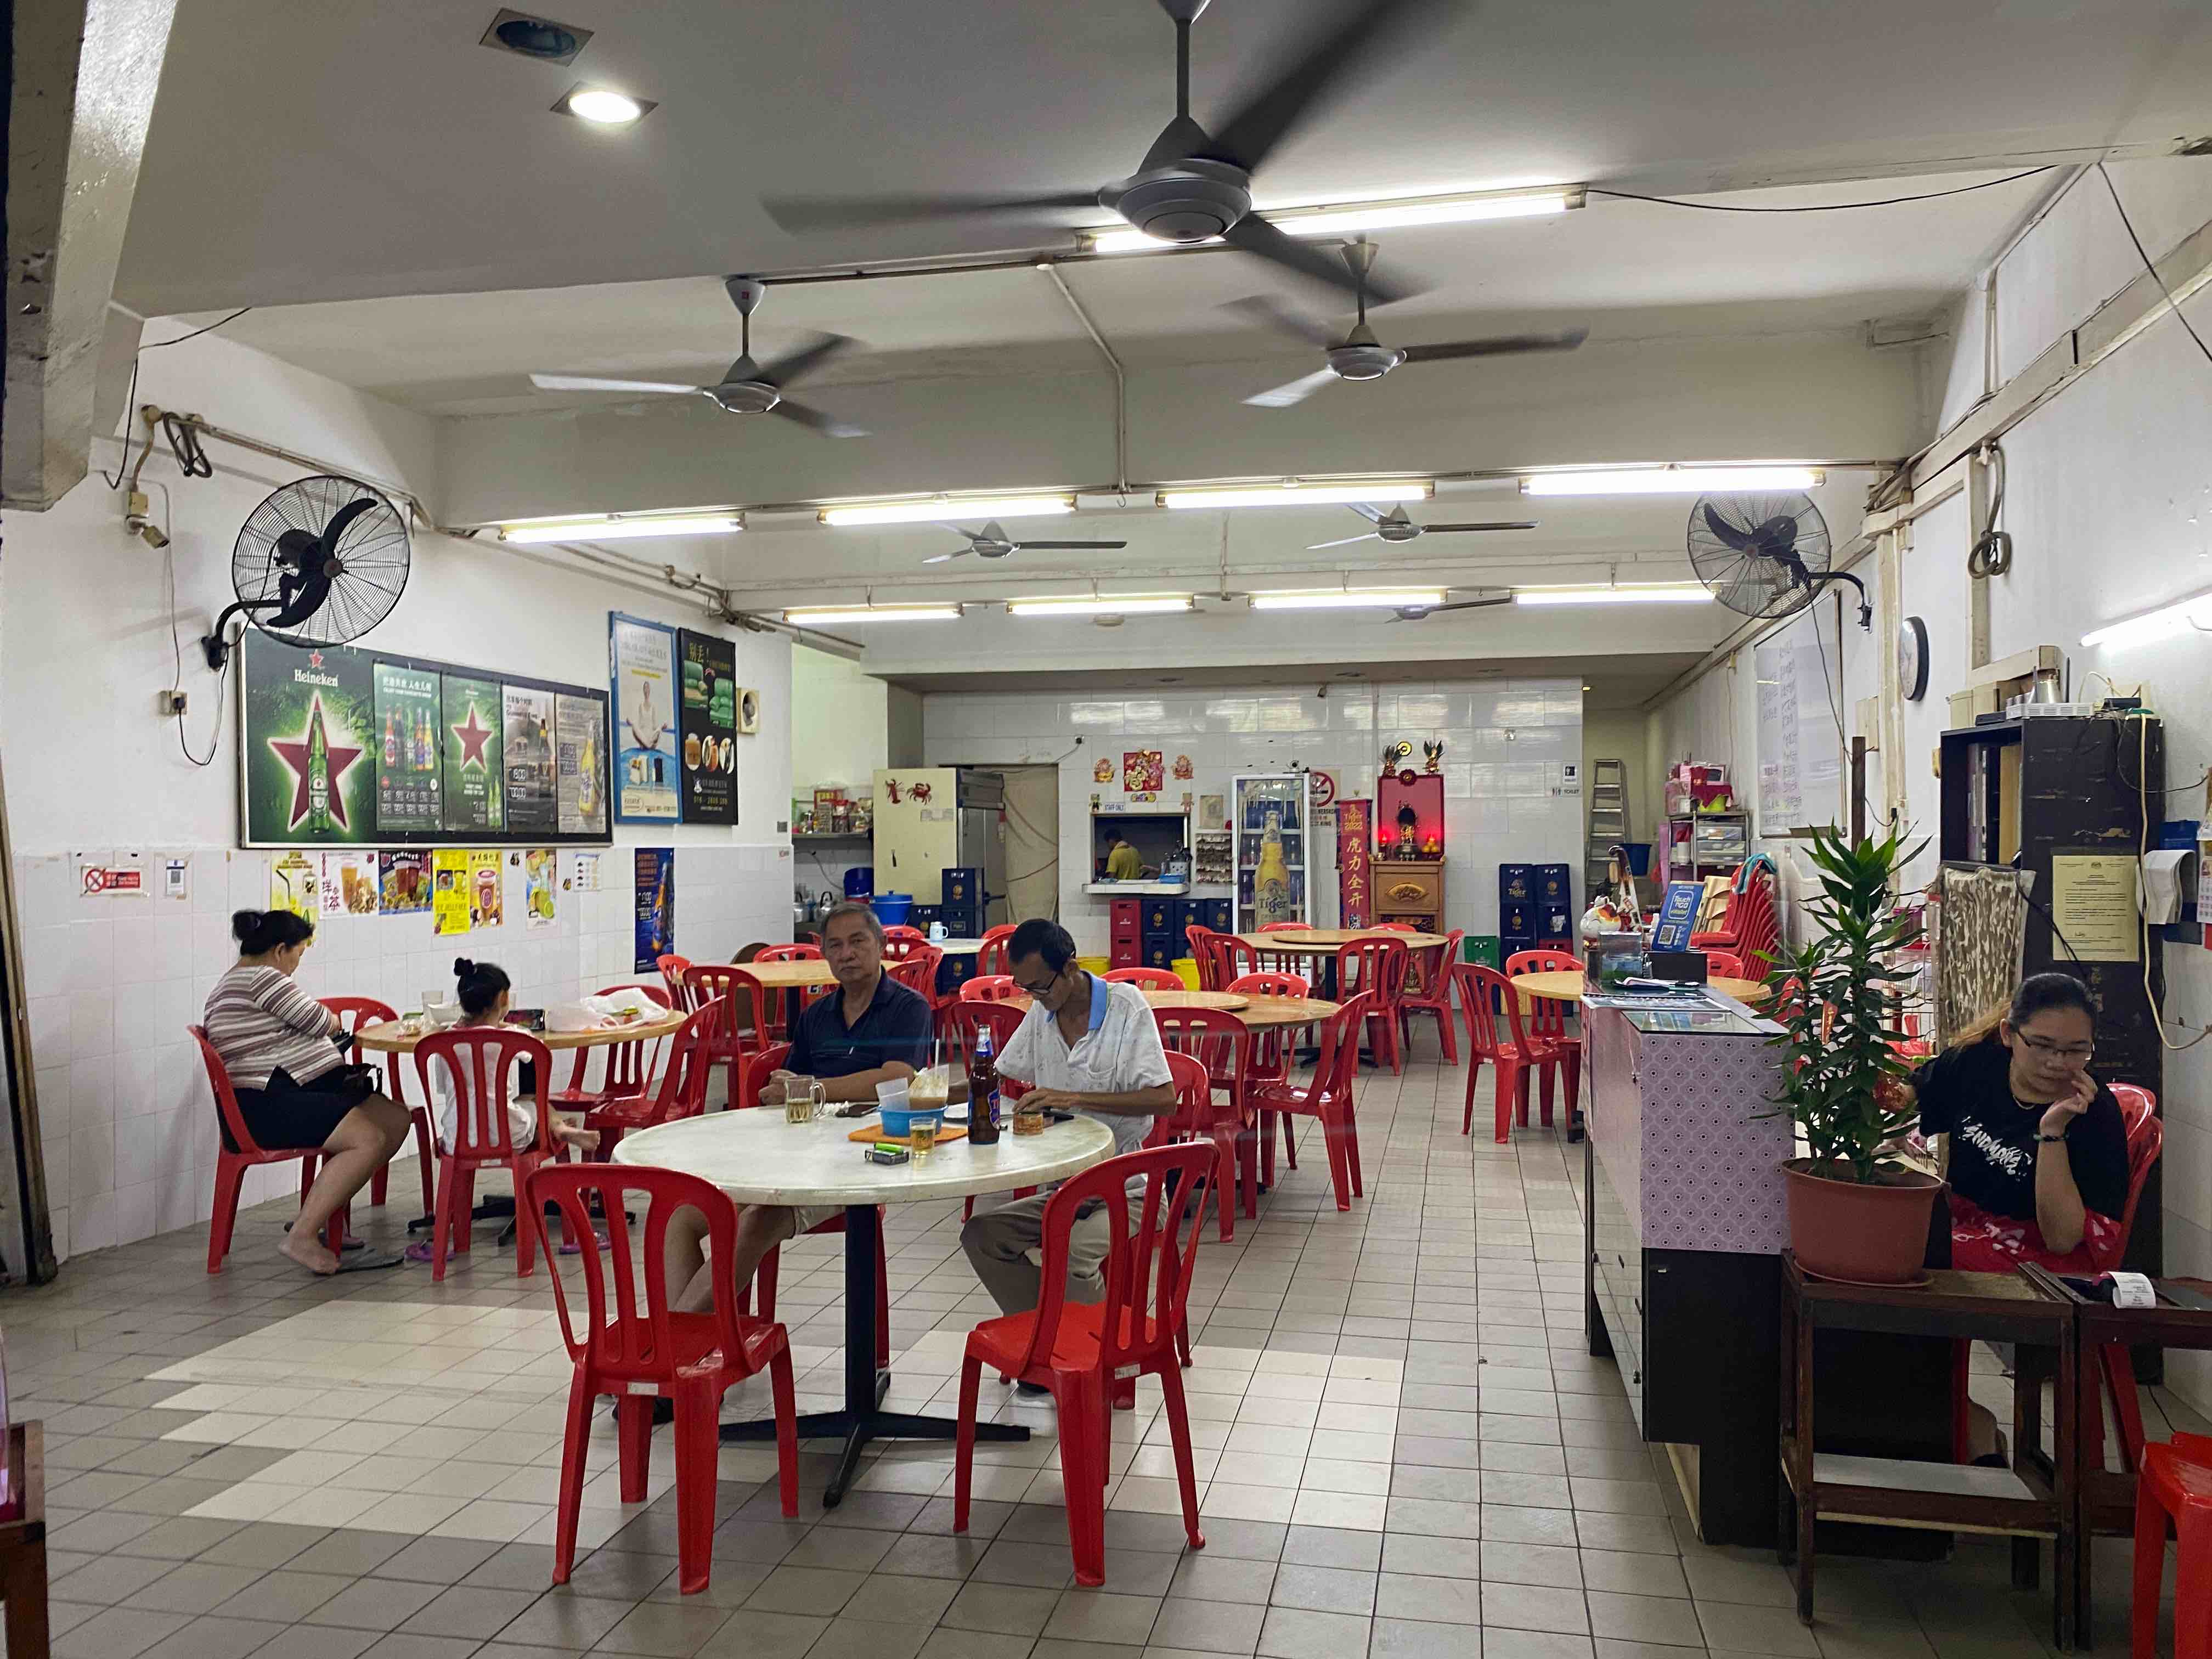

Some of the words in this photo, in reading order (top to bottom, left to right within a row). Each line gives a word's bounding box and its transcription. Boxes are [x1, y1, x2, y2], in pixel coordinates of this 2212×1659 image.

[295, 669, 338, 687] Heineken
[1346, 837, 1364, 908] 虎力全开
[1259, 898, 1288, 913] Tiger
